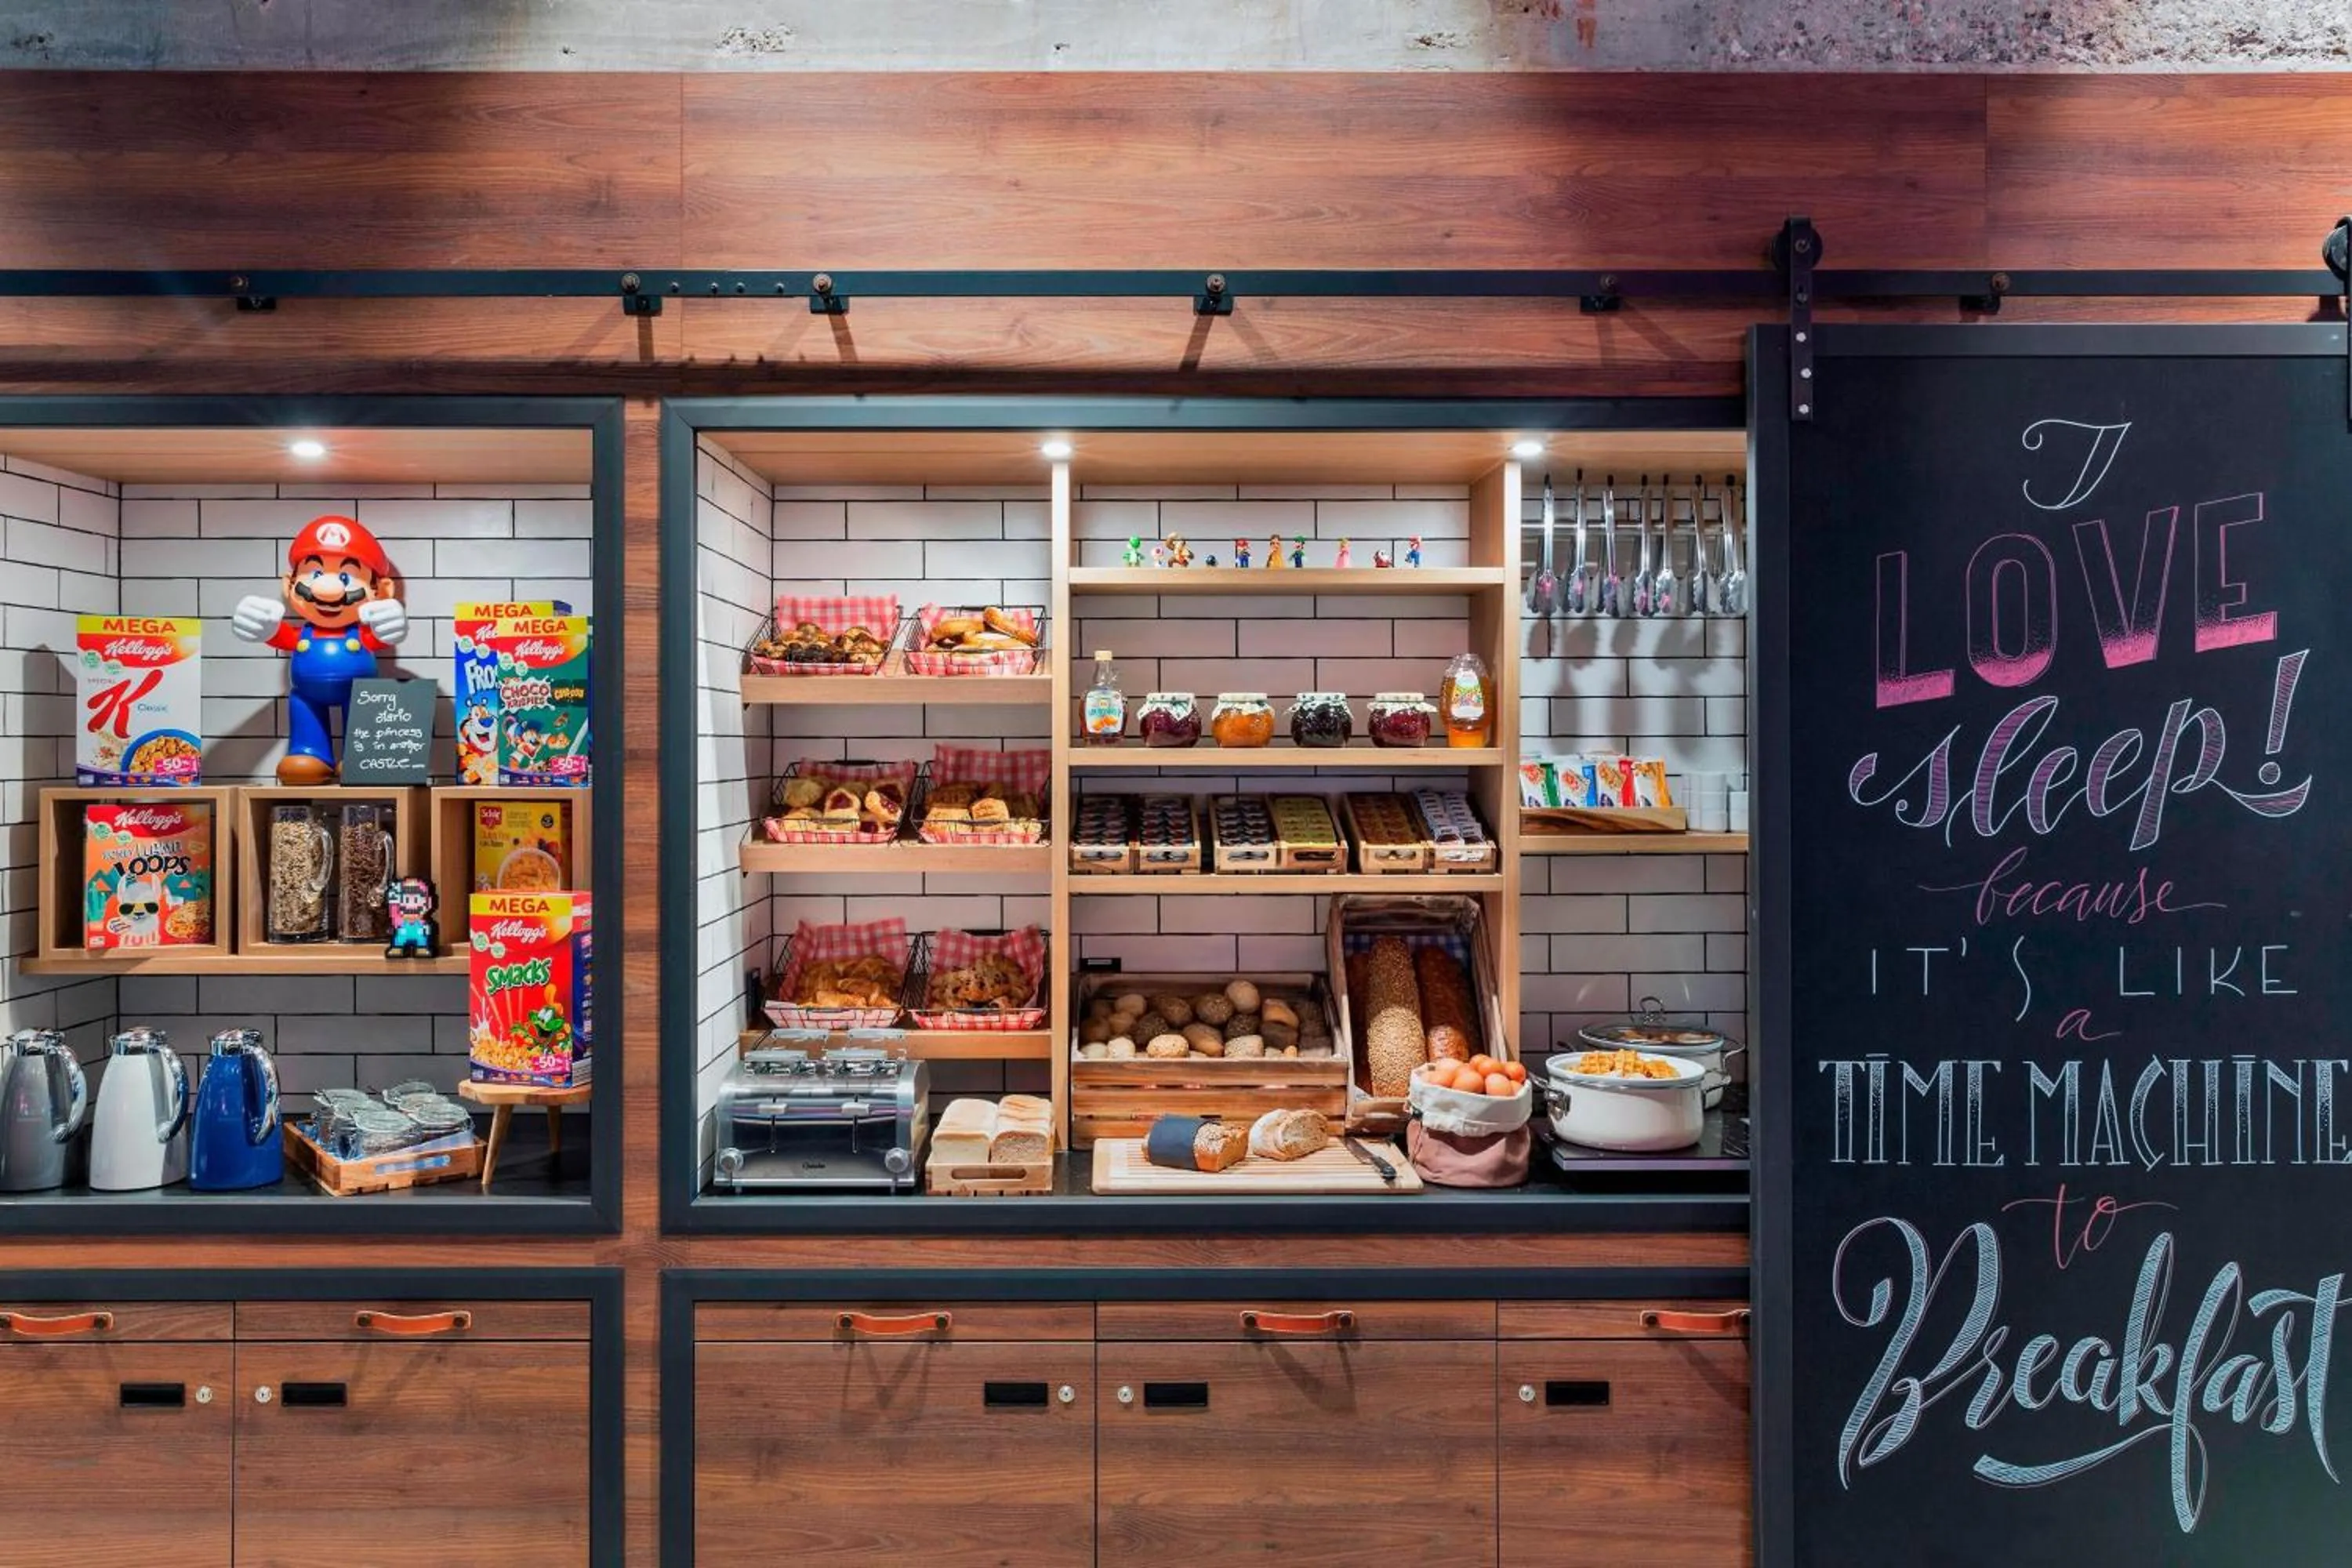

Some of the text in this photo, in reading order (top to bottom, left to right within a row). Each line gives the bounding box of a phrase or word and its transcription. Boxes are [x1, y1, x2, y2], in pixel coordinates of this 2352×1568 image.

[474, 604, 534, 618] MEGA
[1877, 492, 2278, 708] LOVE
[103, 619, 176, 633] MEGA
[514, 619, 569, 634] MEGA
[104, 638, 174, 661] Kellogg's
[514, 639, 565, 660] Kellogg's
[357, 691, 397, 711] Sorry
[501, 684, 550, 699] CHOCO
[87, 670, 164, 739] K
[372, 741, 385, 750] in
[1849, 649, 2311, 851] sleep!
[114, 808, 183, 829] Kellogg's
[1918, 847, 2227, 924] because
[489, 898, 550, 913] MEGA
[491, 919, 548, 944] Kellogg's
[1871, 935, 2298, 1022] IT'S LIKE
[2056, 1007, 2121, 1041] a
[1818, 1053, 2352, 1171] TIME MACHINE
[1832, 1216, 2352, 1534] Breakfast
